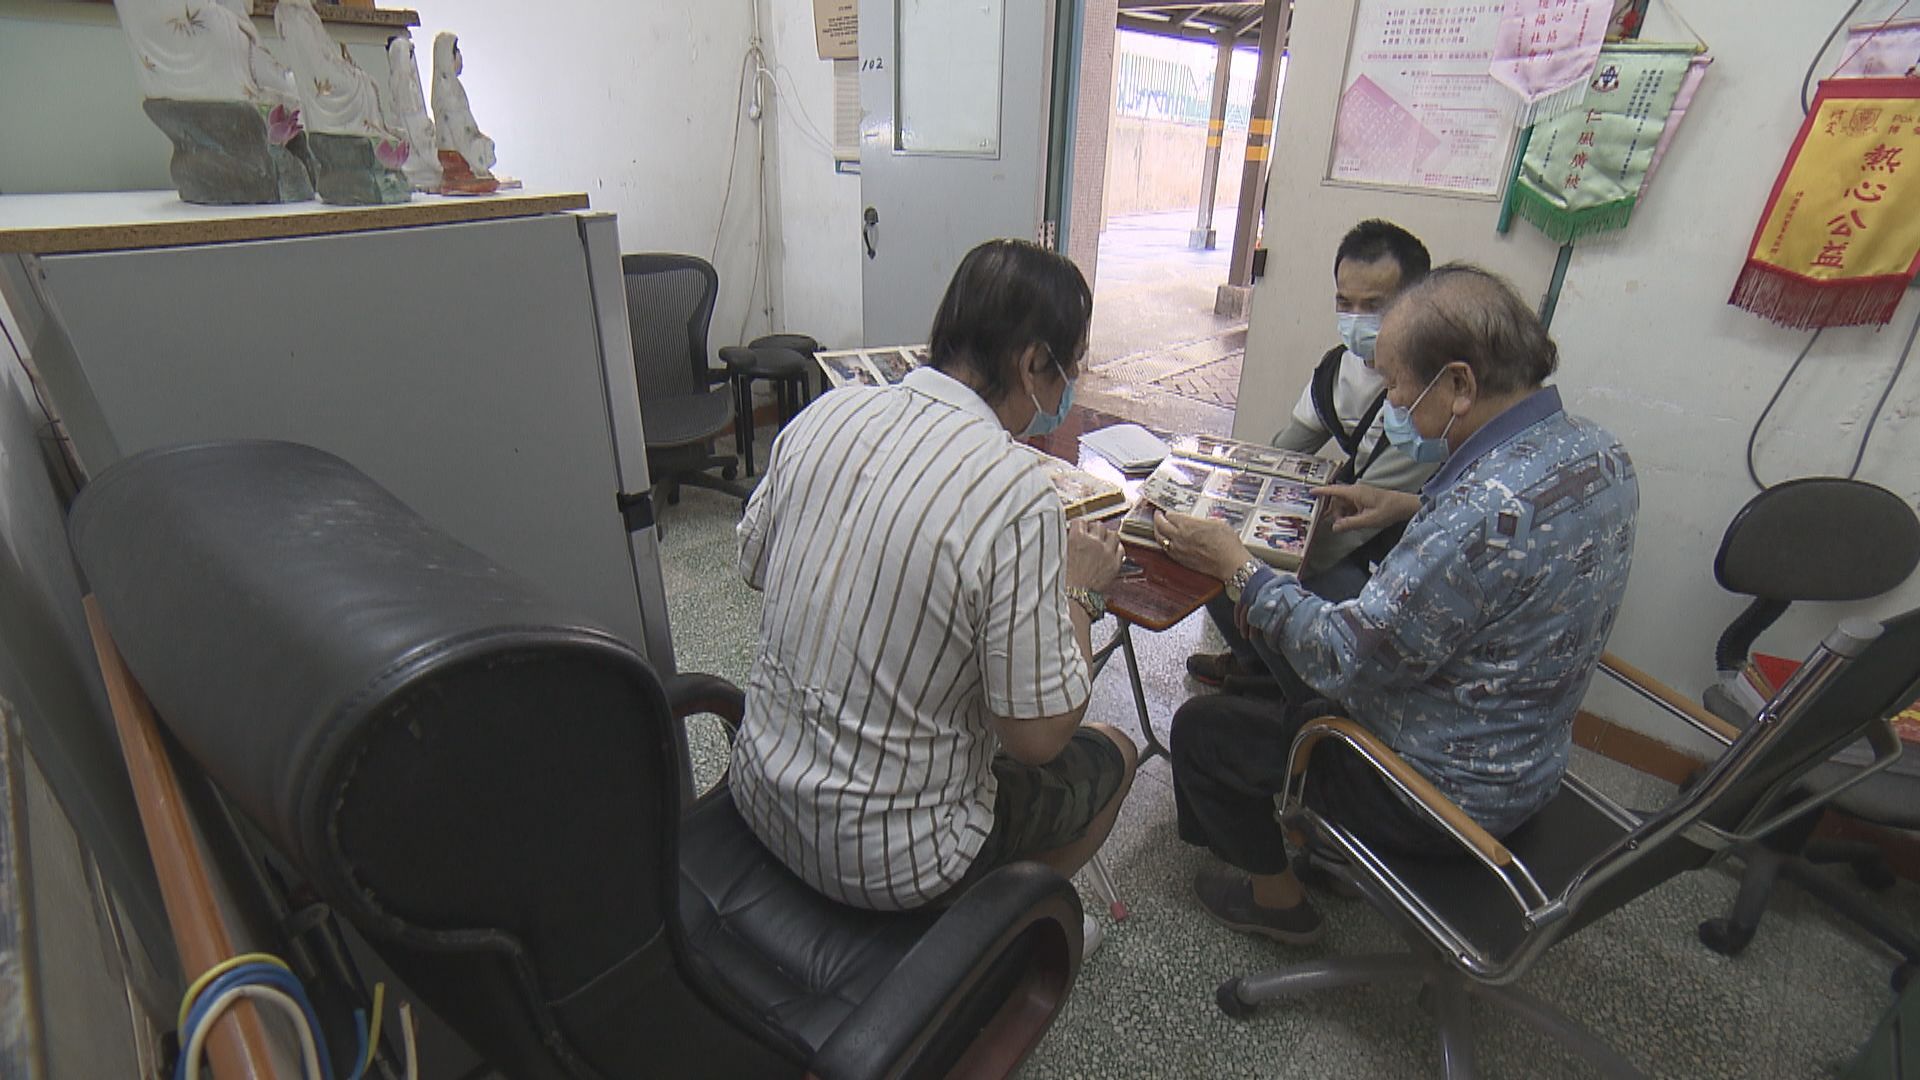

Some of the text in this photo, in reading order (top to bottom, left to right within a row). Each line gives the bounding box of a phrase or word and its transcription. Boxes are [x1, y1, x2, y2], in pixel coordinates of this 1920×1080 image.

[862, 58, 883, 71] 102
[1810, 143, 1903, 269] 熱心公益
